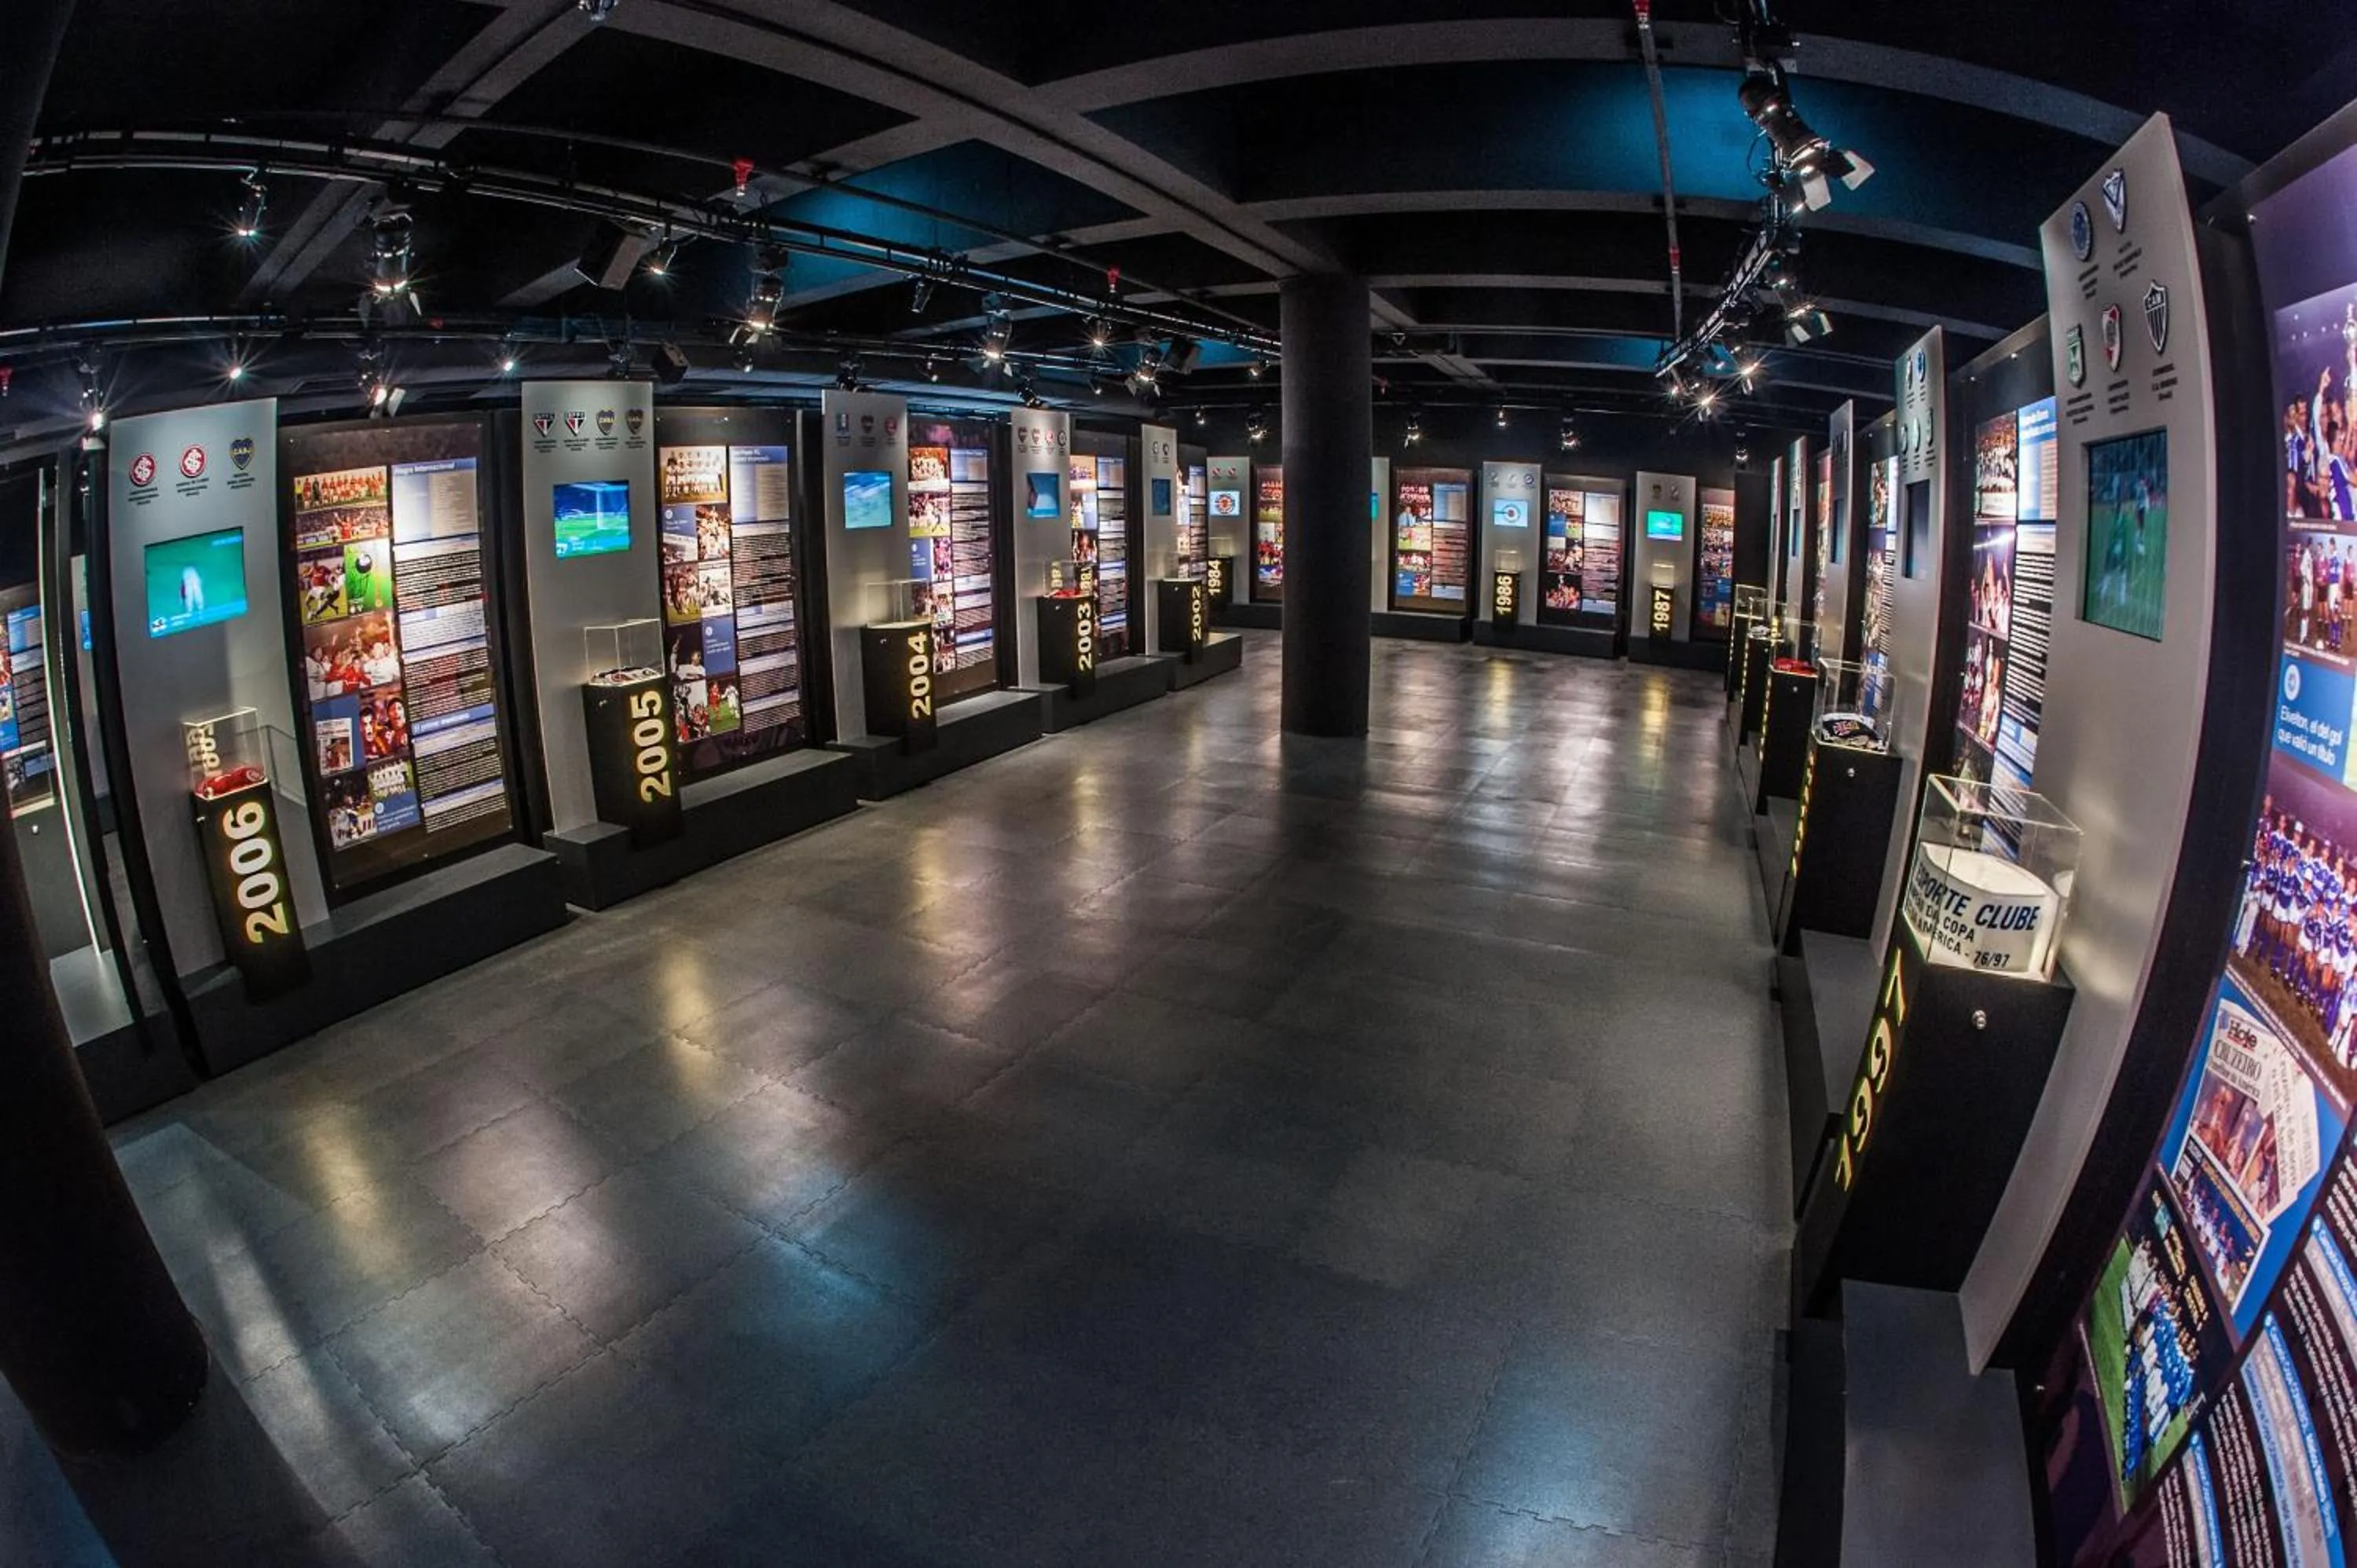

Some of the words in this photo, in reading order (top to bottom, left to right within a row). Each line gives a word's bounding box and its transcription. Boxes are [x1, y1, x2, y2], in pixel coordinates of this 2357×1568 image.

[1208, 559, 1221, 595] 1984
[1496, 575, 1512, 615] 1986
[1077, 603, 1092, 671] 2003
[1192, 585, 1201, 641] 2002
[1653, 590, 1670, 631] 1987
[907, 632, 931, 719] 2004
[630, 691, 672, 802] 2005
[222, 801, 290, 943] 2006
[1915, 863, 1971, 918] PORTE
[1974, 903, 2041, 931] CLUBE
[1943, 916, 1975, 943] COPA
[1973, 951, 2011, 968] 76/97
[2227, 1020, 2258, 1050] Hoje
[1835, 947, 1907, 1192] 1997
